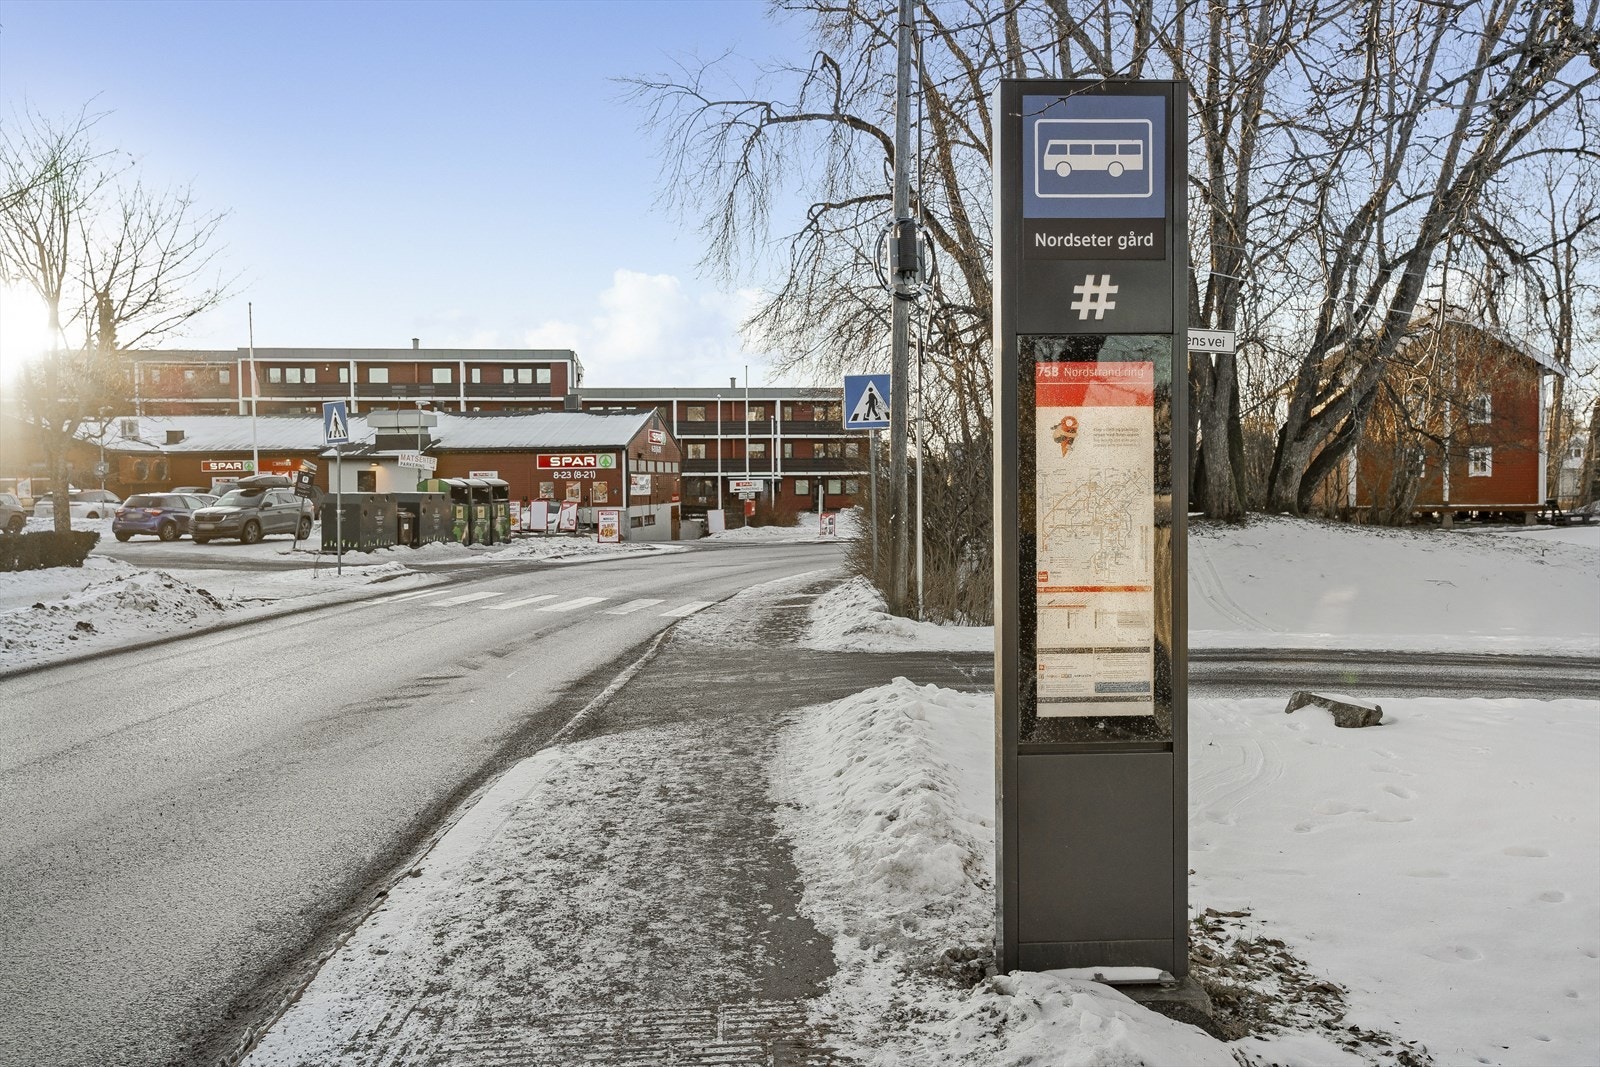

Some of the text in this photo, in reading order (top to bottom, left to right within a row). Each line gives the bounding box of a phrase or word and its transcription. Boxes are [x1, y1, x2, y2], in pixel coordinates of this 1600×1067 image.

[1035, 231, 1154, 250] Nordseter gård
[1208, 336, 1225, 347] vei
[1064, 367, 1121, 377] Nordstrand
[1124, 367, 1144, 379] ring
[209, 462, 242, 470] SPAR
[549, 456, 596, 467] SPAR
[553, 470, 596, 480] 8-23 (8-21)
